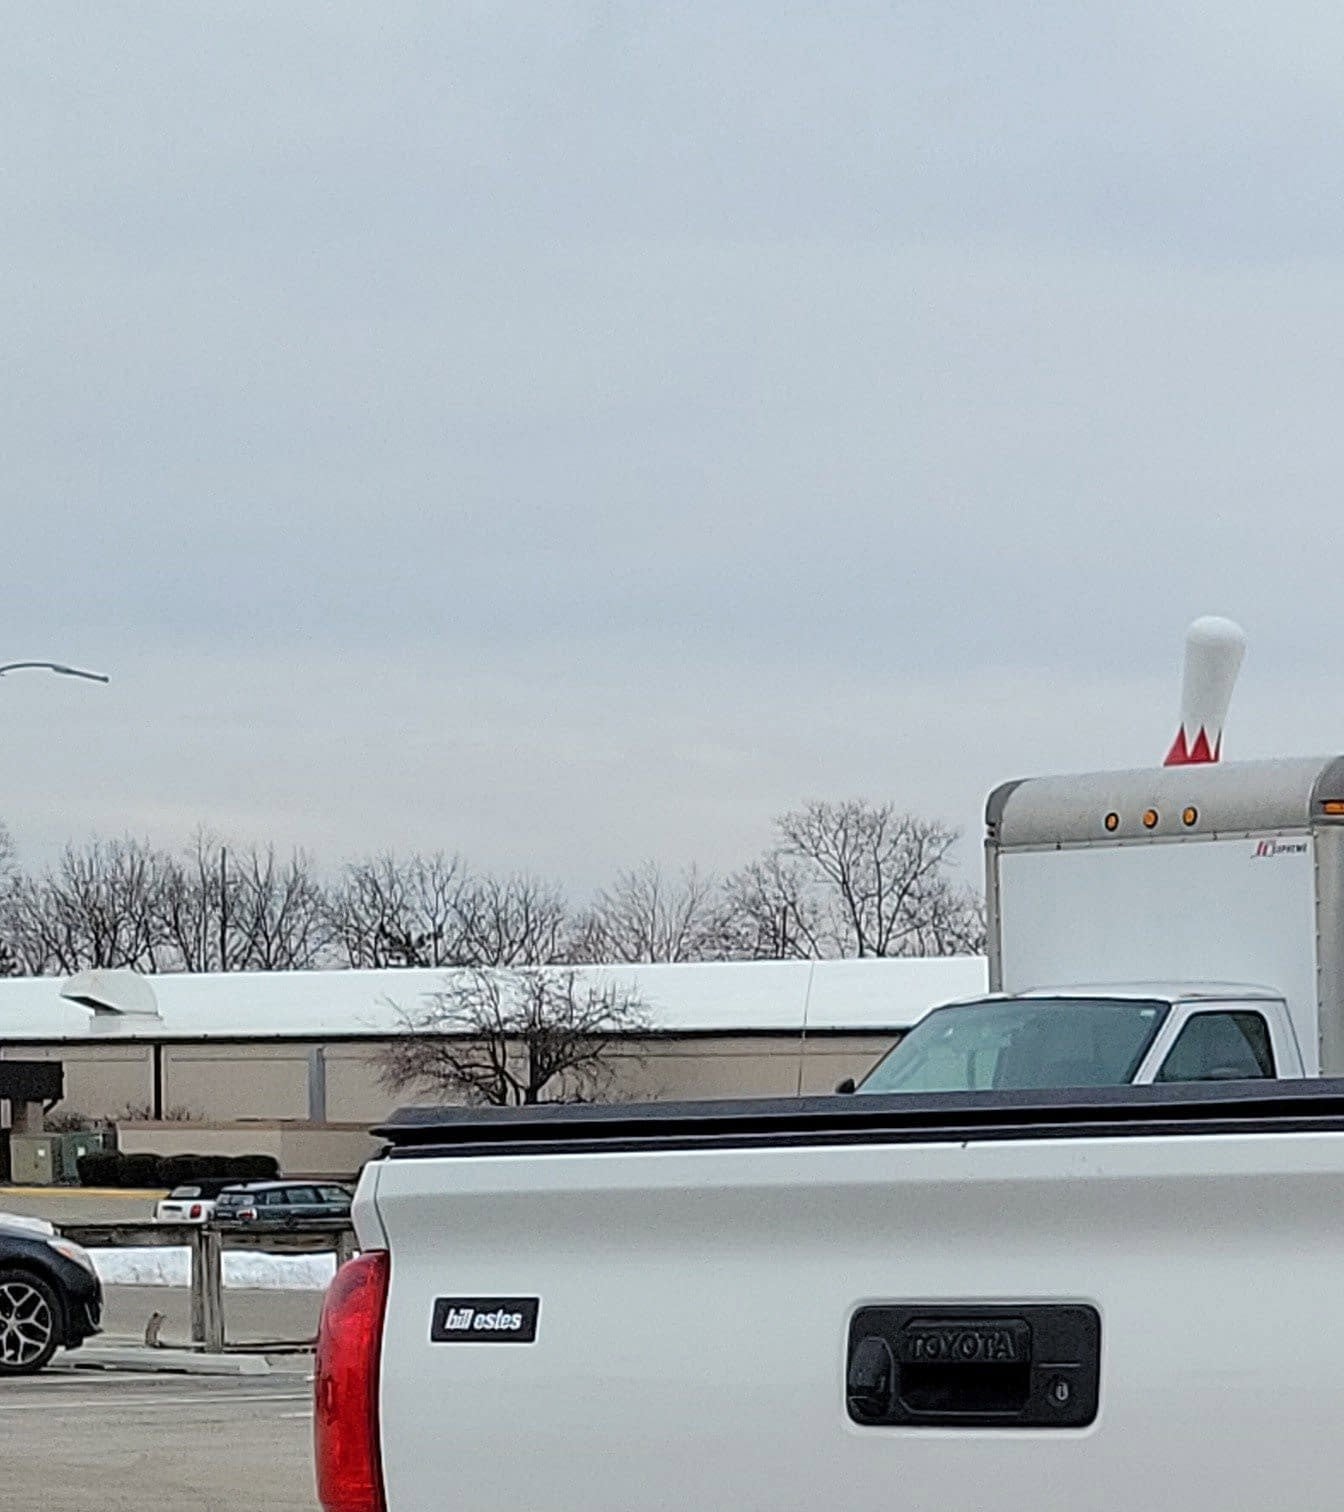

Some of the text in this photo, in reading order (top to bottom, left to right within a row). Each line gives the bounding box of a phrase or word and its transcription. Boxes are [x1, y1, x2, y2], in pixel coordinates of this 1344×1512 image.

[444, 1307, 522, 1331] bill estes
[907, 1331, 1016, 1358] TOYOTA
